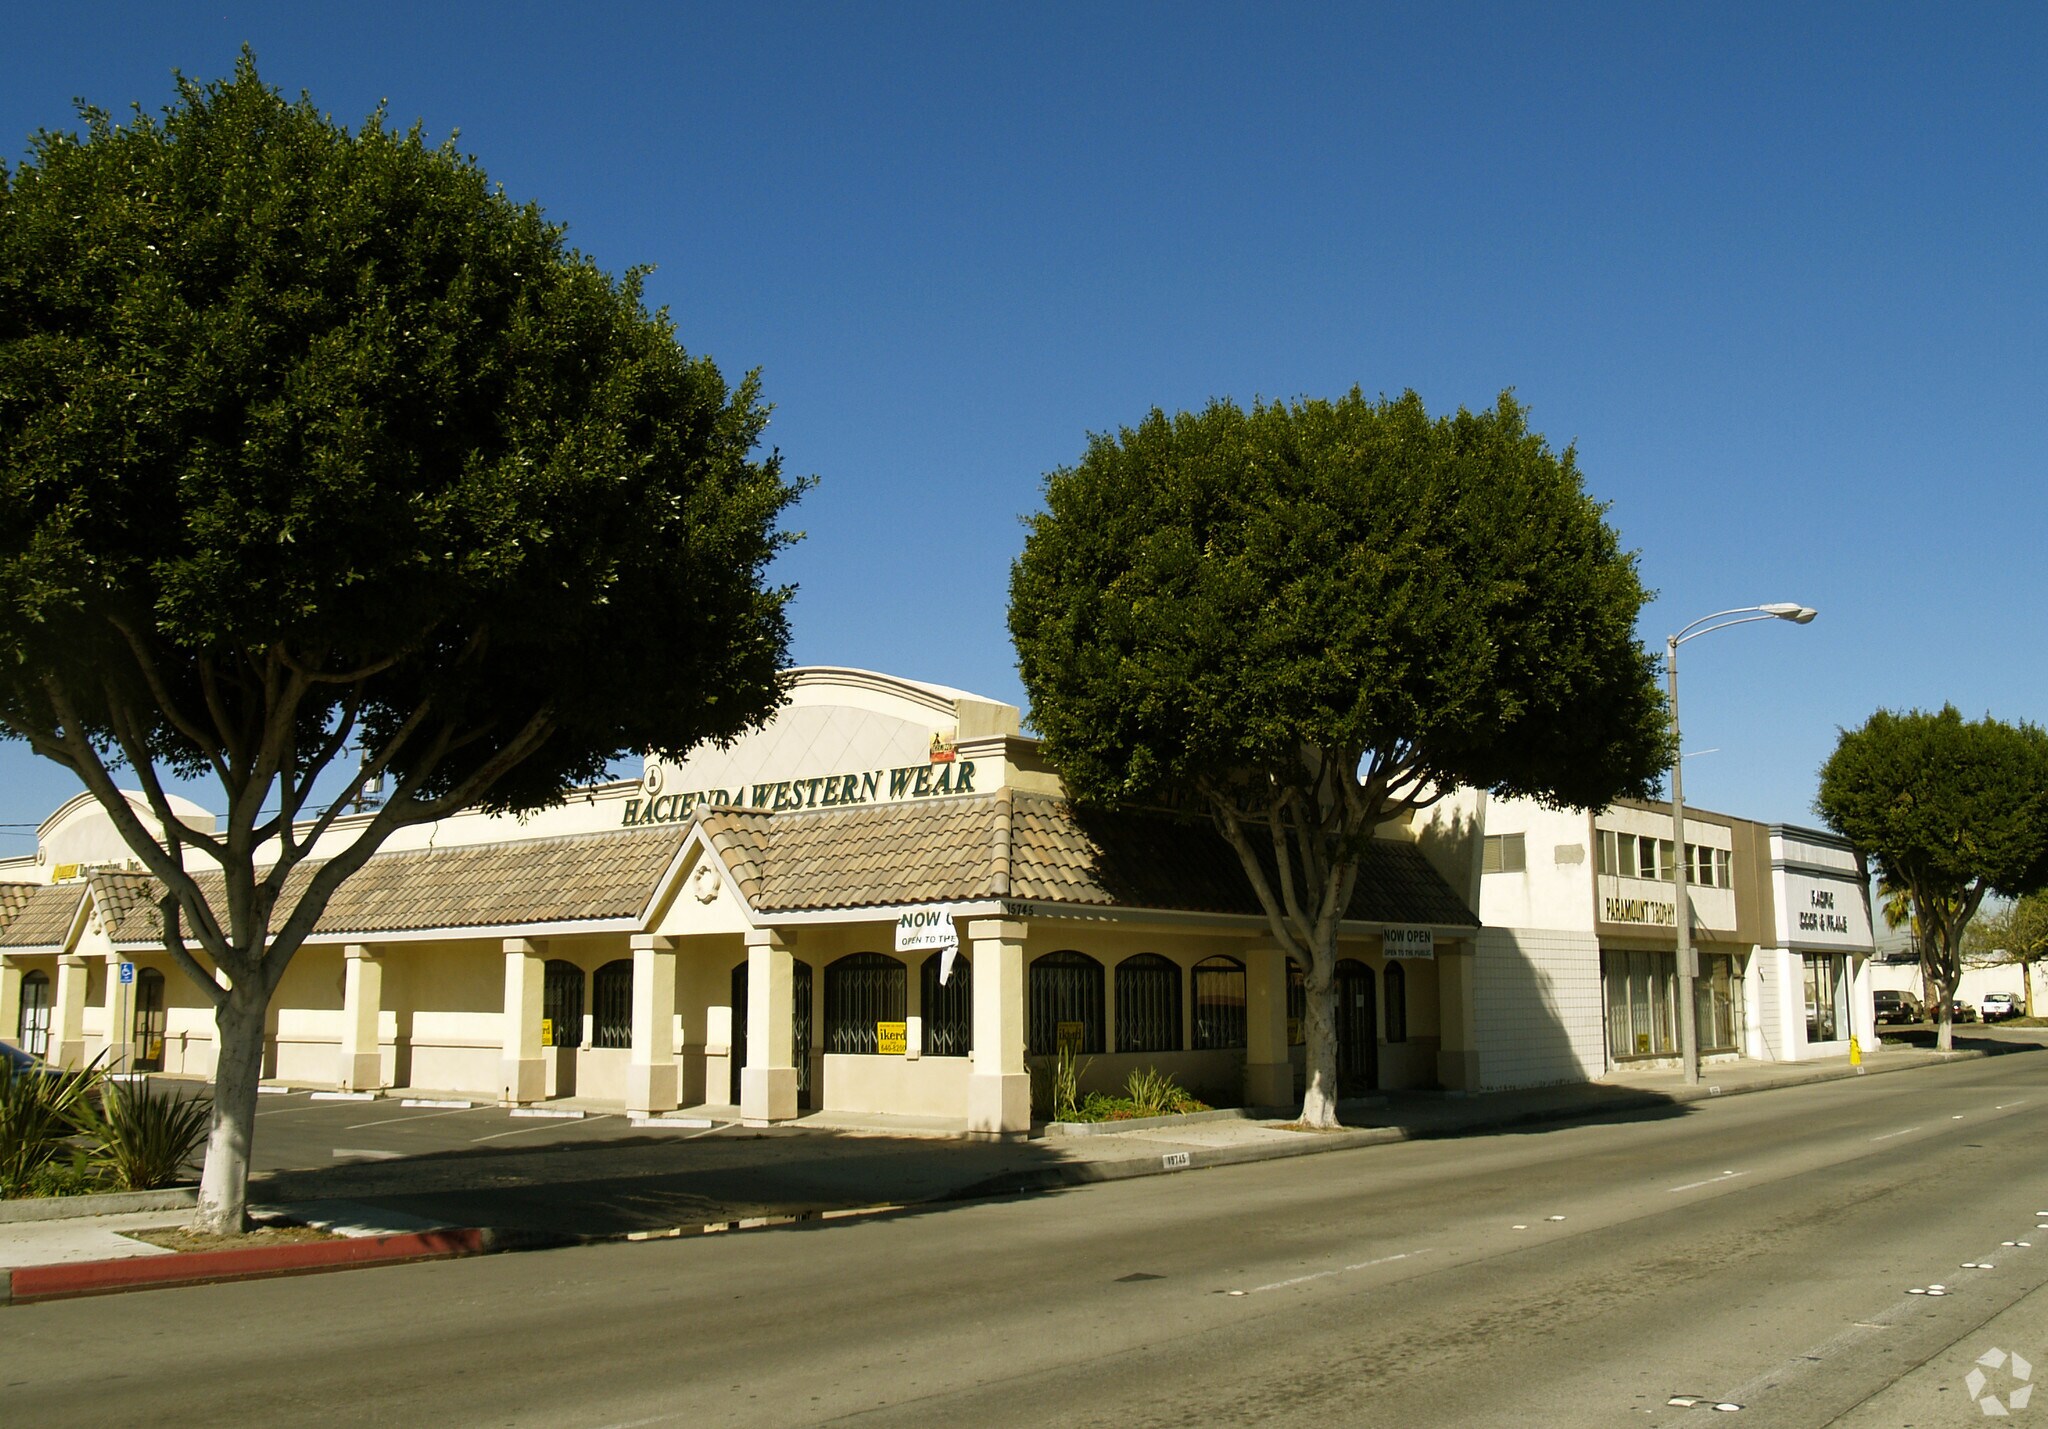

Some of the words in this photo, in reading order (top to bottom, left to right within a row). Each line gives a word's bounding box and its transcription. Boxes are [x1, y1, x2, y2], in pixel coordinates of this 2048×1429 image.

[622, 789, 745, 827] HACIENDA
[751, 770, 884, 812] WESTERN
[889, 761, 976, 799] WEAR
[1007, 902, 1034, 916] 15745
[1606, 897, 1649, 923] PARAMOUNT
[900, 911, 941, 928] NOW
[901, 935, 922, 946] OPEN
[925, 935, 936, 944] TO
[938, 934, 956, 943] THE
[1384, 929, 1405, 942] NOW
[1407, 930, 1431, 943] OPEN
[879, 1028, 907, 1041] ikerd
